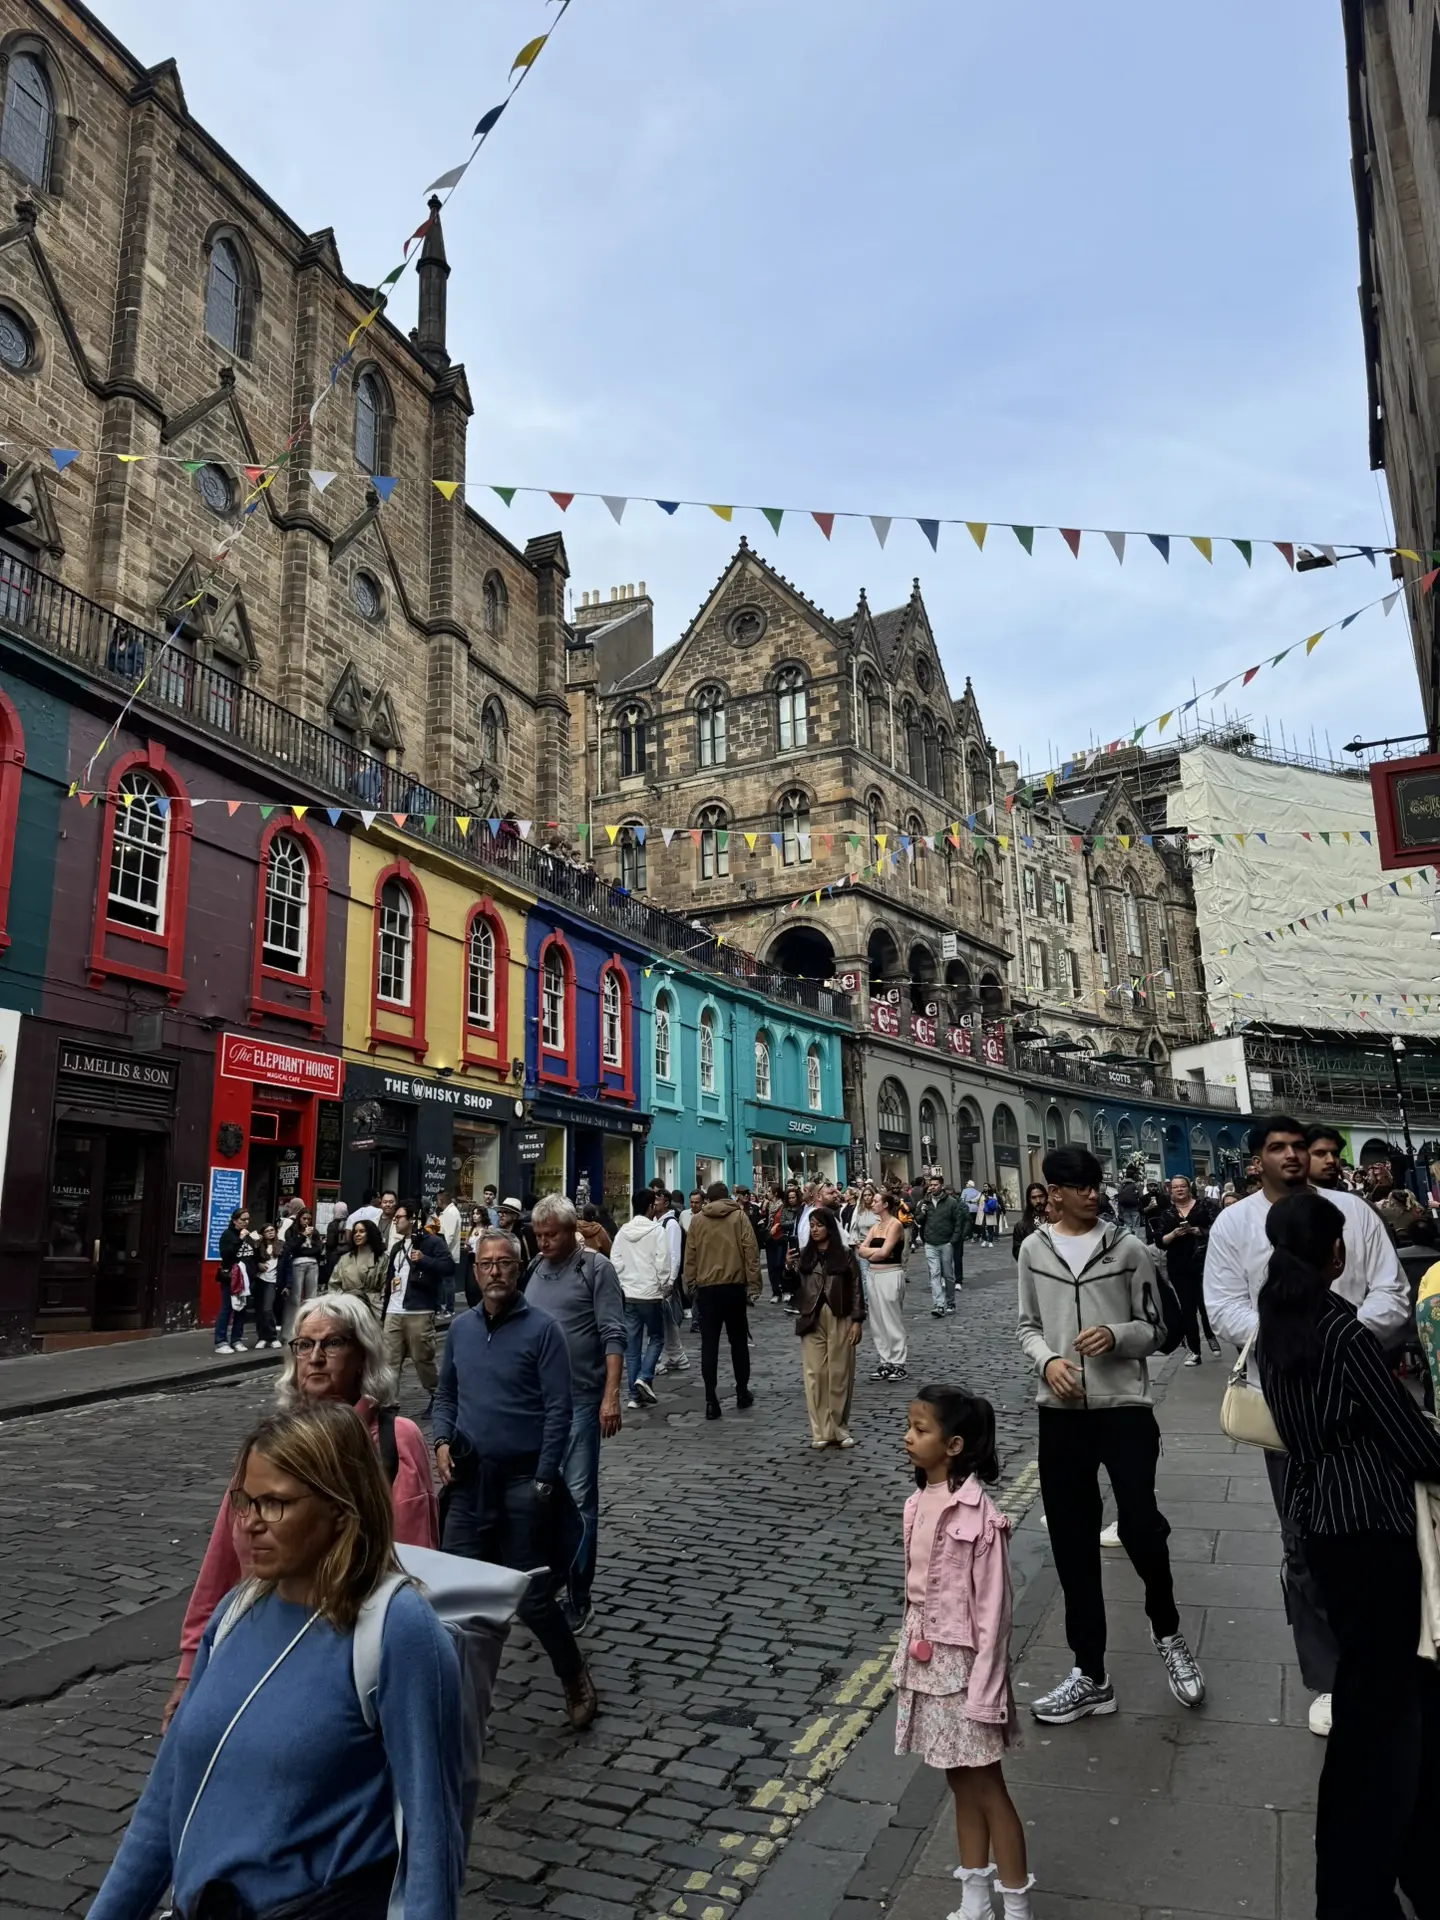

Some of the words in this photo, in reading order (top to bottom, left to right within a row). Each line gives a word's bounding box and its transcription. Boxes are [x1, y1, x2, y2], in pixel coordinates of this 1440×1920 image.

[1058, 948, 1067, 983] SCOTTS
[83, 1056, 130, 1078] MELLIS
[132, 1065, 141, 1080] &
[144, 1067, 169, 1085] SON
[229, 1043, 256, 1064] The
[253, 1049, 305, 1074] ELEPHANT
[305, 1060, 335, 1080] HOUSE
[266, 1071, 288, 1081] MAGICAL
[1108, 1071, 1131, 1084] SCOTTS
[384, 1077, 409, 1095] THE
[412, 1081, 461, 1104] WHISKY
[463, 1093, 493, 1110] SHOP
[788, 1120, 817, 1135] SWISH
[518, 1142, 544, 1151] WHISKY
